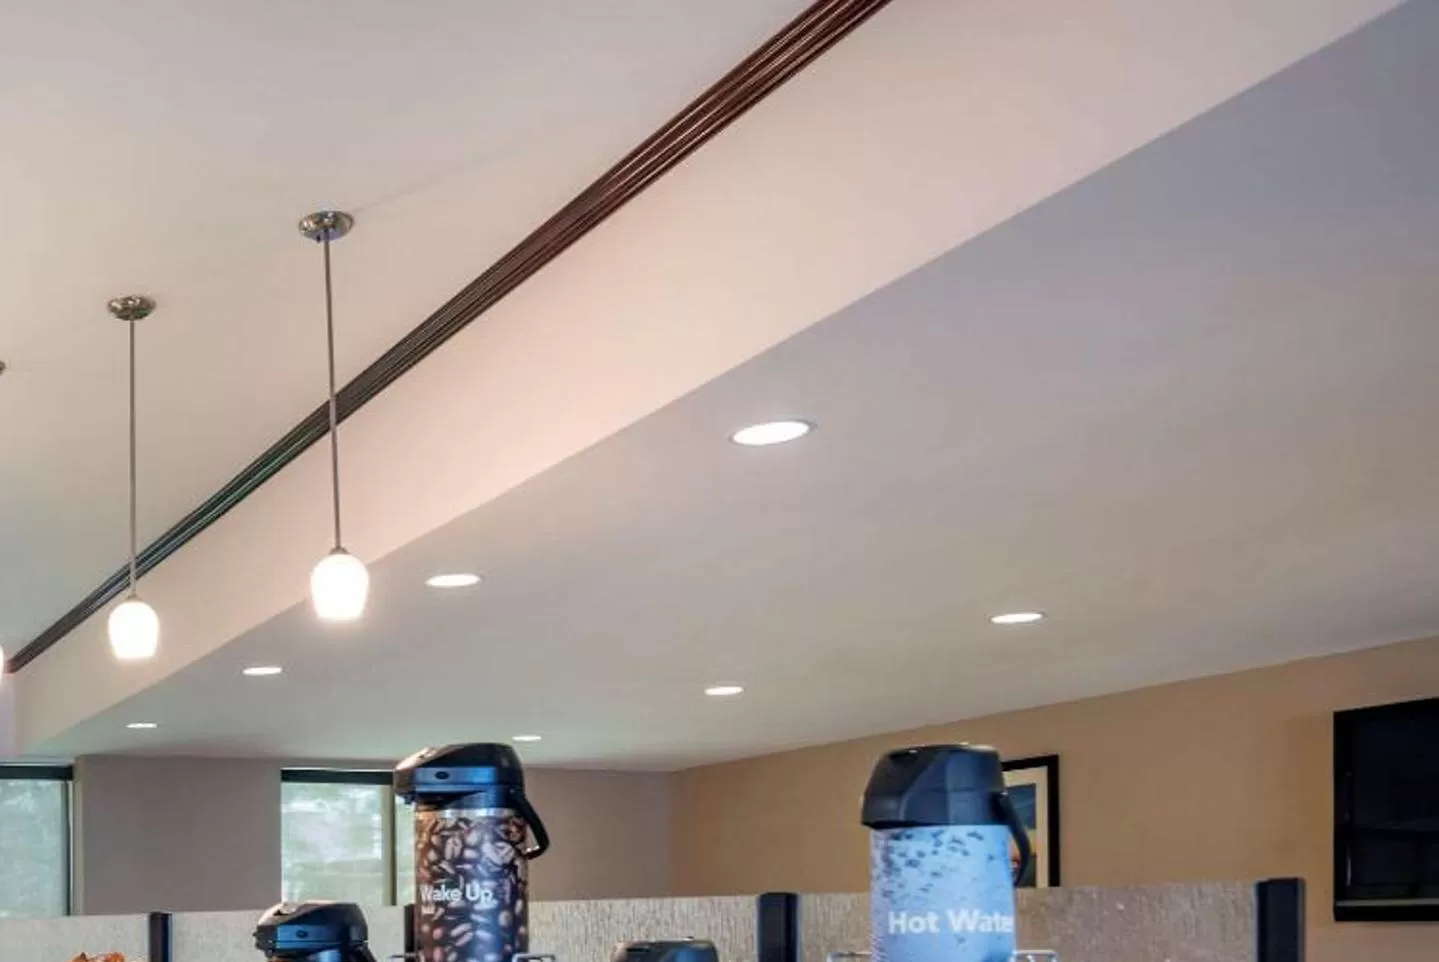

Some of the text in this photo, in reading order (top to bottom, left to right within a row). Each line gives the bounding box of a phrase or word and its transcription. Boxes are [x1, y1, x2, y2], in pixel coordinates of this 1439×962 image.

[420, 882, 495, 905] Wake Up
[887, 908, 1014, 935] Hot Wate
